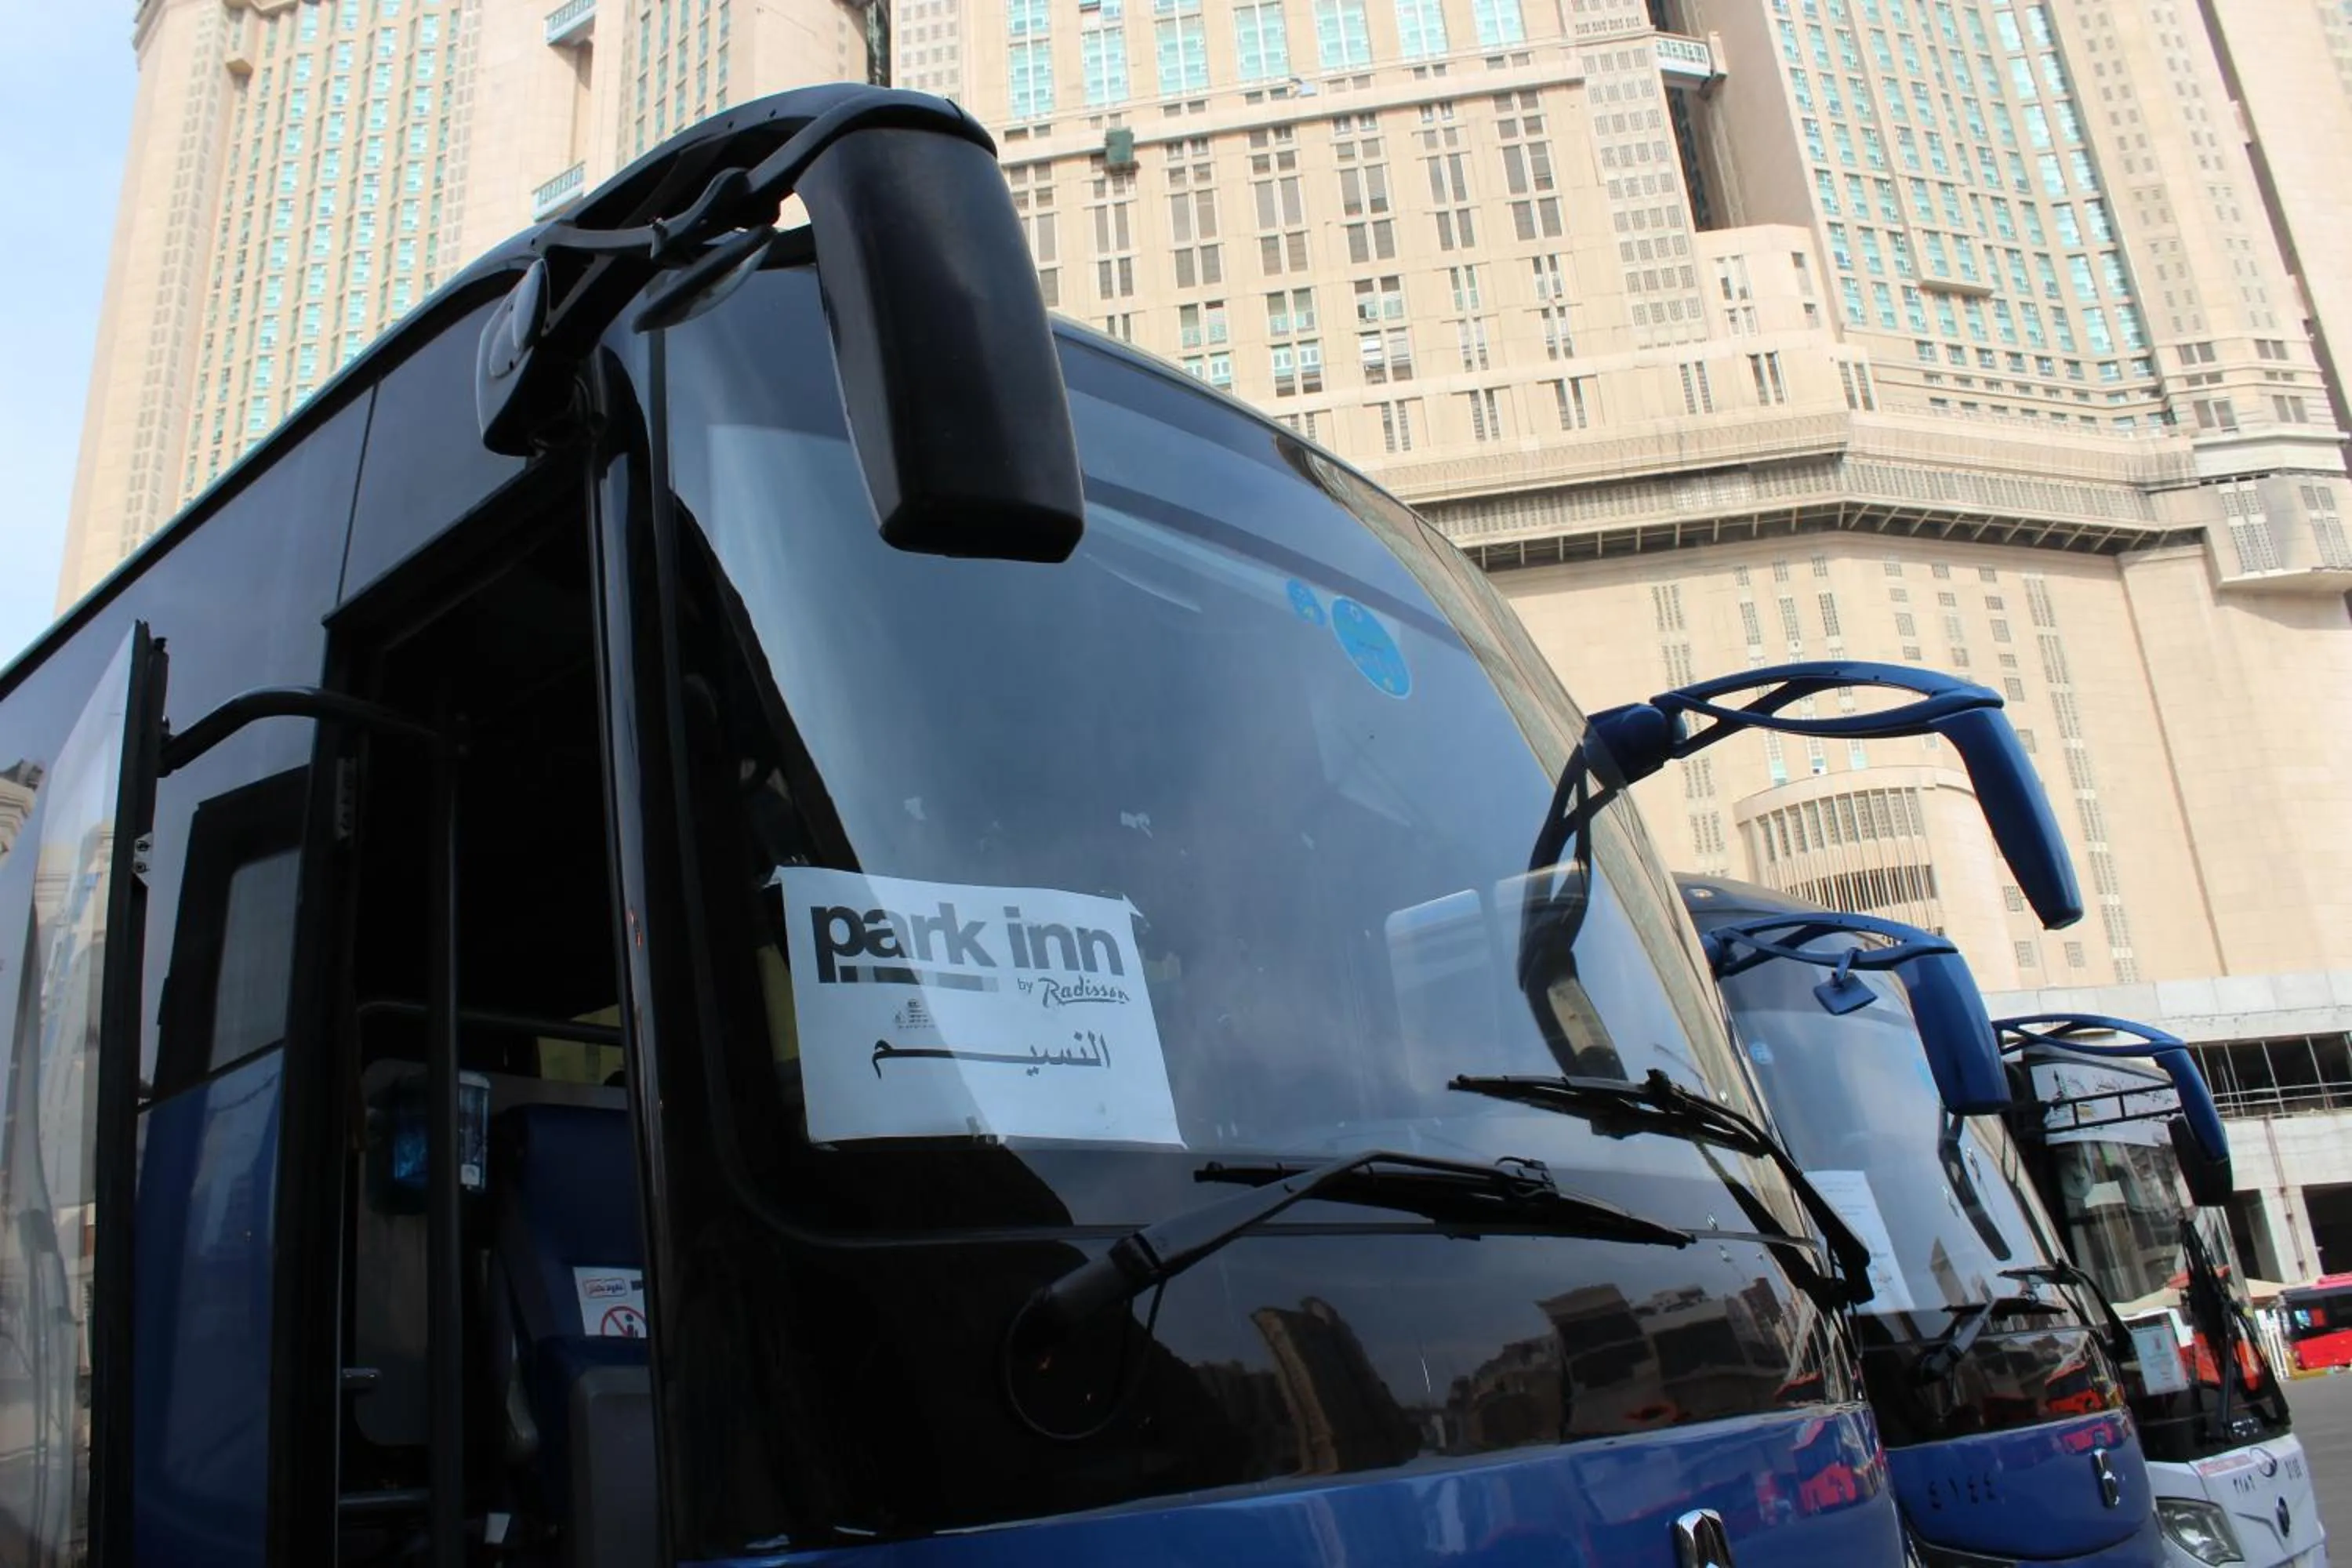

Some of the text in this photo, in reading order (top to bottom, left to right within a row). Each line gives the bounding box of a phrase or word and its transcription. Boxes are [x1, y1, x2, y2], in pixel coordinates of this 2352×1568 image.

[810, 902, 1125, 984] park inn
[1018, 975, 1130, 1007] by Radisson
